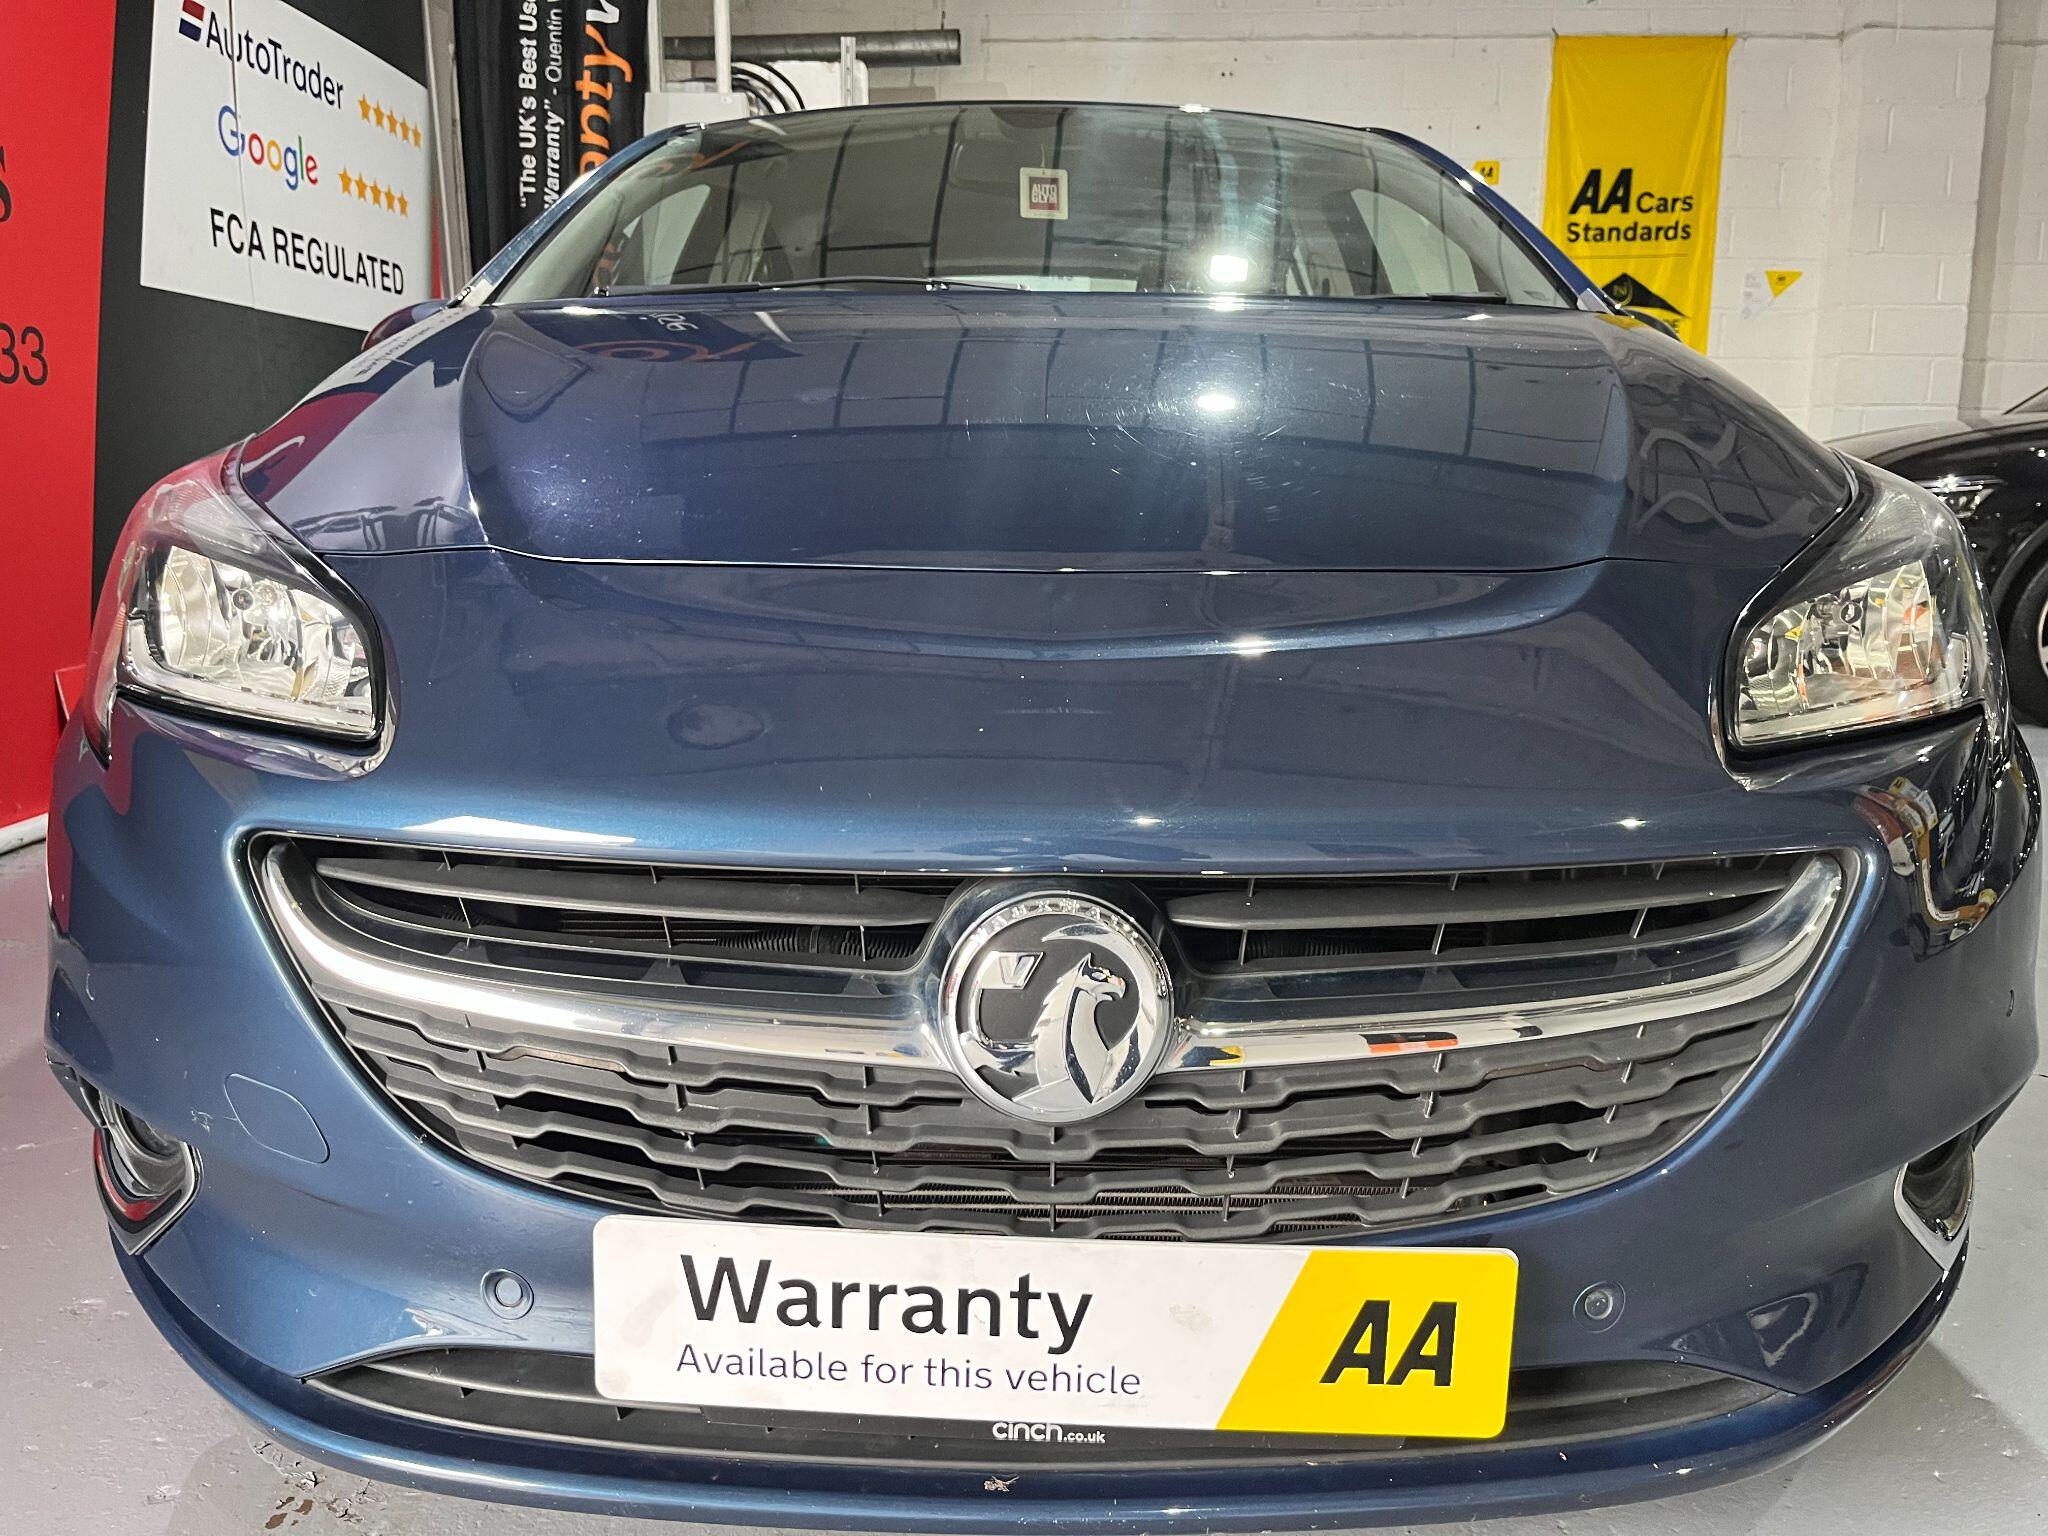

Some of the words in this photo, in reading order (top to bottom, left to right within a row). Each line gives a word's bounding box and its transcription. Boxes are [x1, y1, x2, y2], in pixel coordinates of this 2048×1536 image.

[518, 0, 538, 32] Us
[544, 9, 563, 82] Quentin
[206, 11, 343, 109] AutoTrader
[518, 36, 538, 90] Best
[218, 105, 319, 191] Google
[518, 96, 537, 149] UK's
[1569, 168, 1633, 214] AA
[1636, 191, 1694, 213] Cars
[210, 207, 266, 260] FCA
[272, 226, 404, 295] REGULATED
[1567, 221, 1692, 243] Standards
[680, 1254, 1094, 1355] Warranty
[676, 1343, 849, 1382] Available
[861, 1354, 914, 1386] for
[923, 1357, 994, 1391] this
[1004, 1363, 1143, 1396] vehicle
[1319, 1299, 1458, 1387] AA
